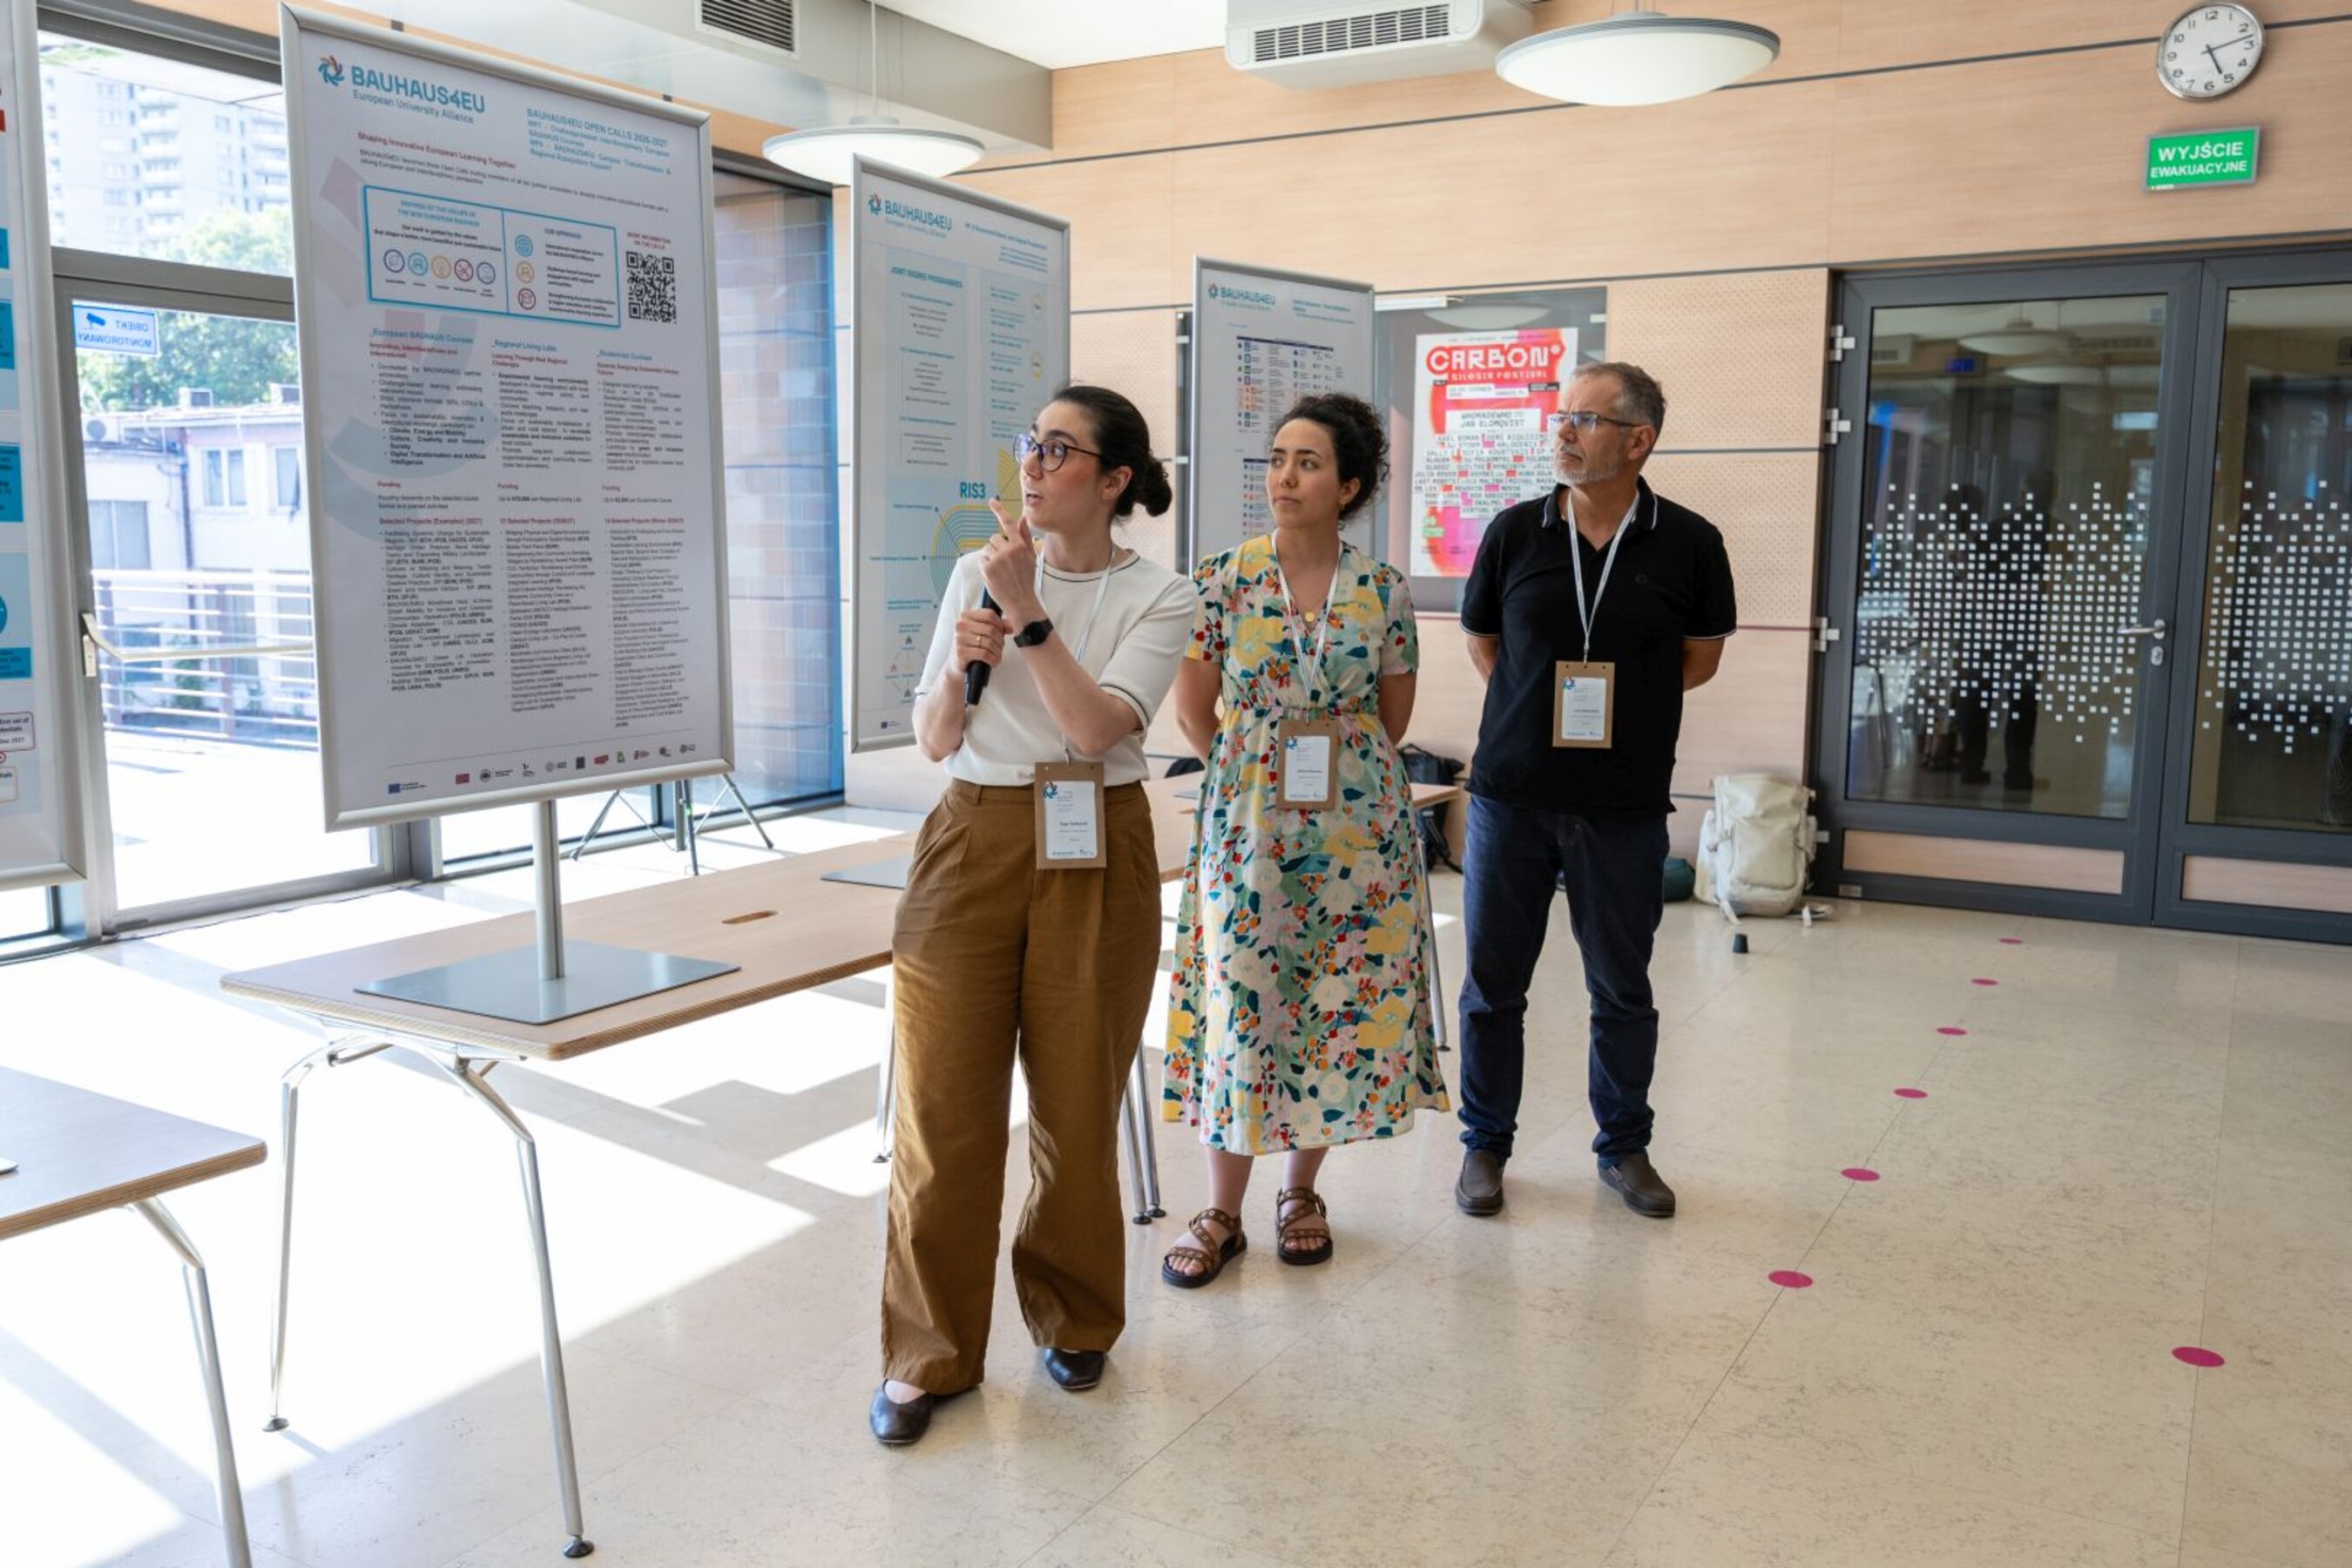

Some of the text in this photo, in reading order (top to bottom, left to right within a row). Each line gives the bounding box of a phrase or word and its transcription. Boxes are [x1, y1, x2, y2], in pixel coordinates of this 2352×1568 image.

[2206, 10, 2219, 21] 12
[2188, 20, 2196, 30] 11
[2239, 24, 2249, 33] 2
[2174, 34, 2184, 43] 10
[2244, 41, 2254, 50] 3
[2167, 52, 2177, 61] 9
[2238, 58, 2247, 67] 4
[2173, 69, 2184, 78] 8
[2224, 73, 2234, 83] 5
[351, 65, 486, 113] BAUHAUS4EU
[2187, 79, 2195, 89] 7
[2205, 81, 2214, 91] 6
[353, 89, 475, 124] European University Alliance
[585, 121, 606, 133] OPEN
[608, 127, 632, 140] CALLS
[2159, 141, 2244, 161] WYJŚCIE
[426, 145, 458, 158] European
[459, 151, 487, 165] Learning
[489, 157, 517, 169] Together
[2150, 160, 2247, 179] EWAKUACYJNE
[885, 200, 952, 232] BAUHAUS4EU
[1220, 286, 1276, 305] BAUHAUS4EU
[960, 482, 986, 498] RIS3
